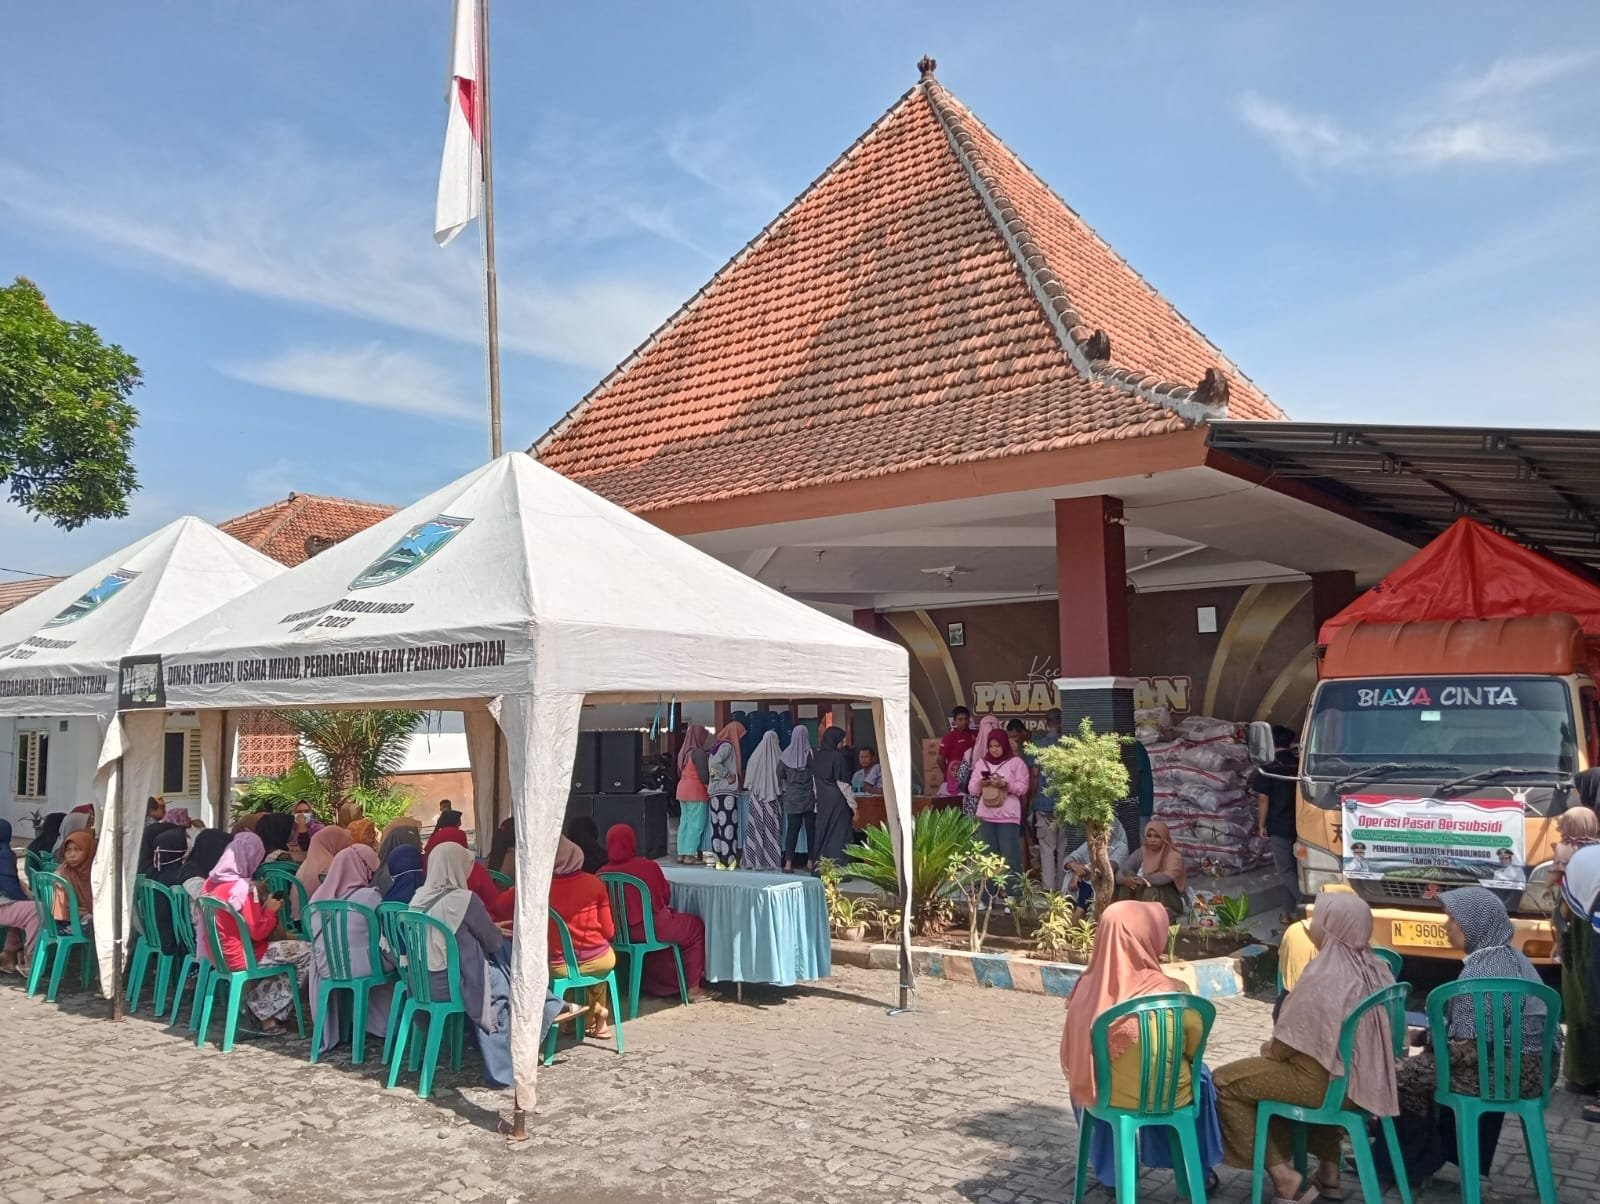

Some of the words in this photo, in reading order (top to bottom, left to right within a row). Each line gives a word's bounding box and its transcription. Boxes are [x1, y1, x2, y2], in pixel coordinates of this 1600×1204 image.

[332, 598, 415, 614] ROBOLINGGO
[316, 615, 356, 629] 2023
[167, 664, 192, 686] DINAS
[237, 658, 267, 682] USAHA
[303, 650, 382, 679] PERDAGANGAN
[381, 648, 406, 674] DAN
[406, 639, 506, 673] PERINDUSTRIAN
[0, 678, 39, 697] ERDAGANGAN
[53, 674, 108, 696] PERINDUSTRIAN
[1357, 686, 1432, 707] BIAYA
[1439, 686, 1519, 706] CINTA
[1358, 815, 1401, 829] Operasi
[1402, 817, 1436, 830] Pasar
[1438, 818, 1502, 833] Bersubsidi
[1394, 923, 1402, 937] N
